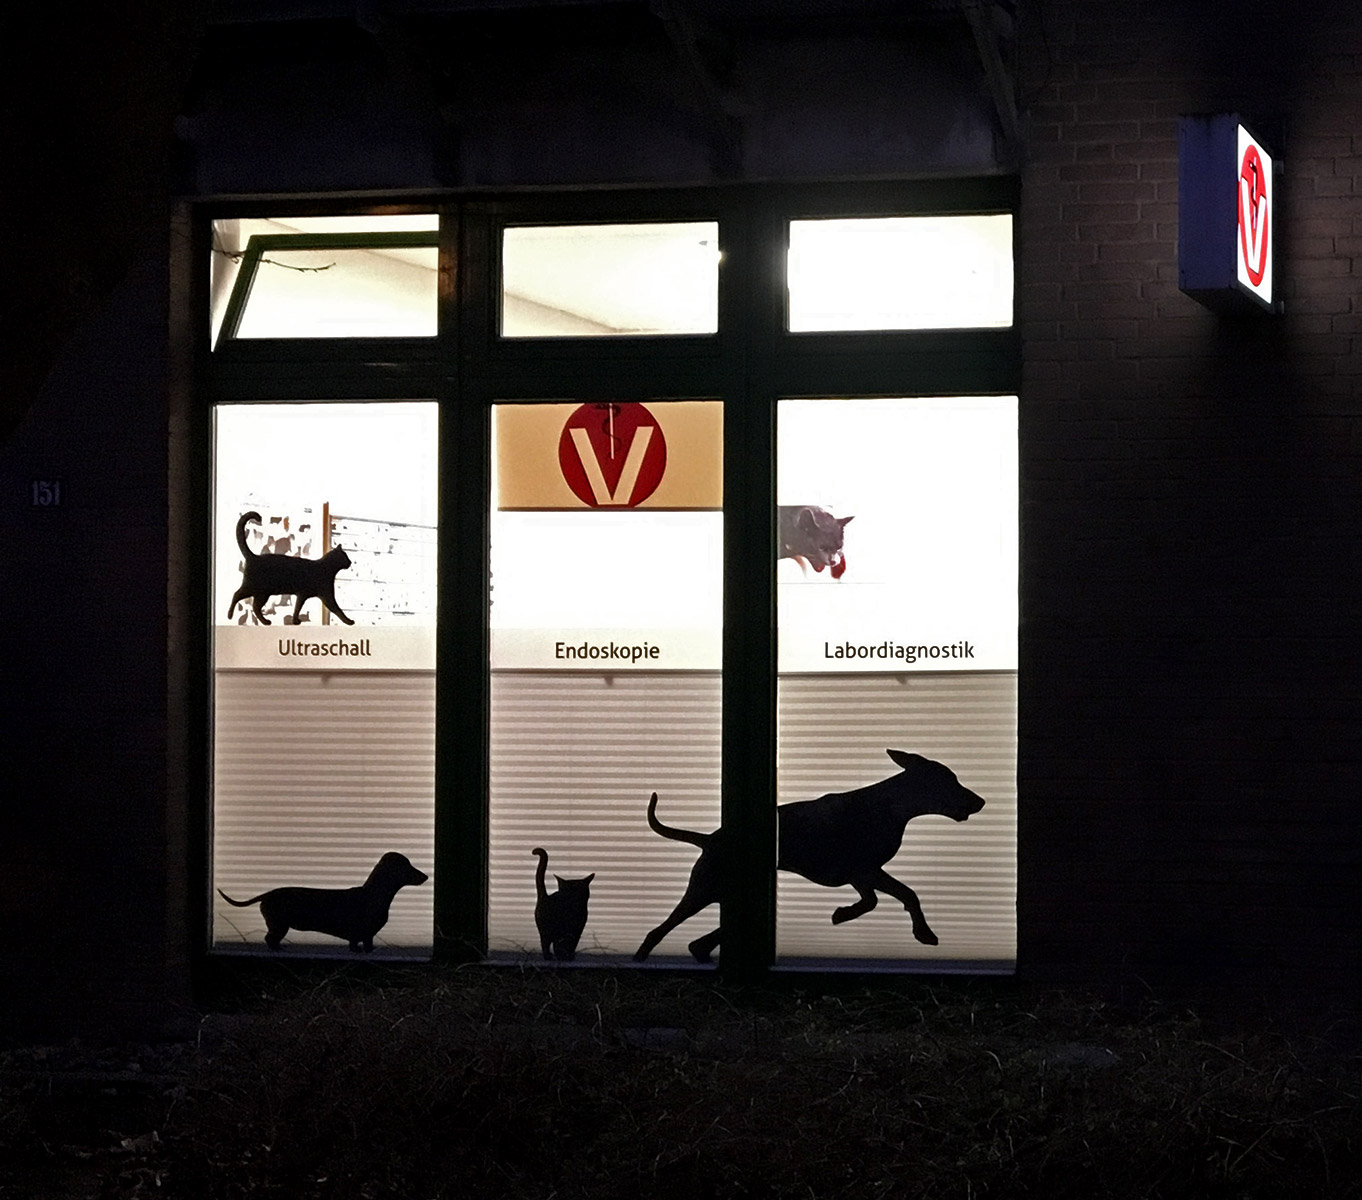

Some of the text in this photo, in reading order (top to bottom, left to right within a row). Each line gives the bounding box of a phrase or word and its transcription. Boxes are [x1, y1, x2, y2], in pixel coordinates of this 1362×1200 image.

[31, 480, 61, 506] 151
[278, 638, 371, 657] Ultraschall
[555, 641, 660, 664] Endoskopie
[824, 641, 975, 664] Labordiagnostik
